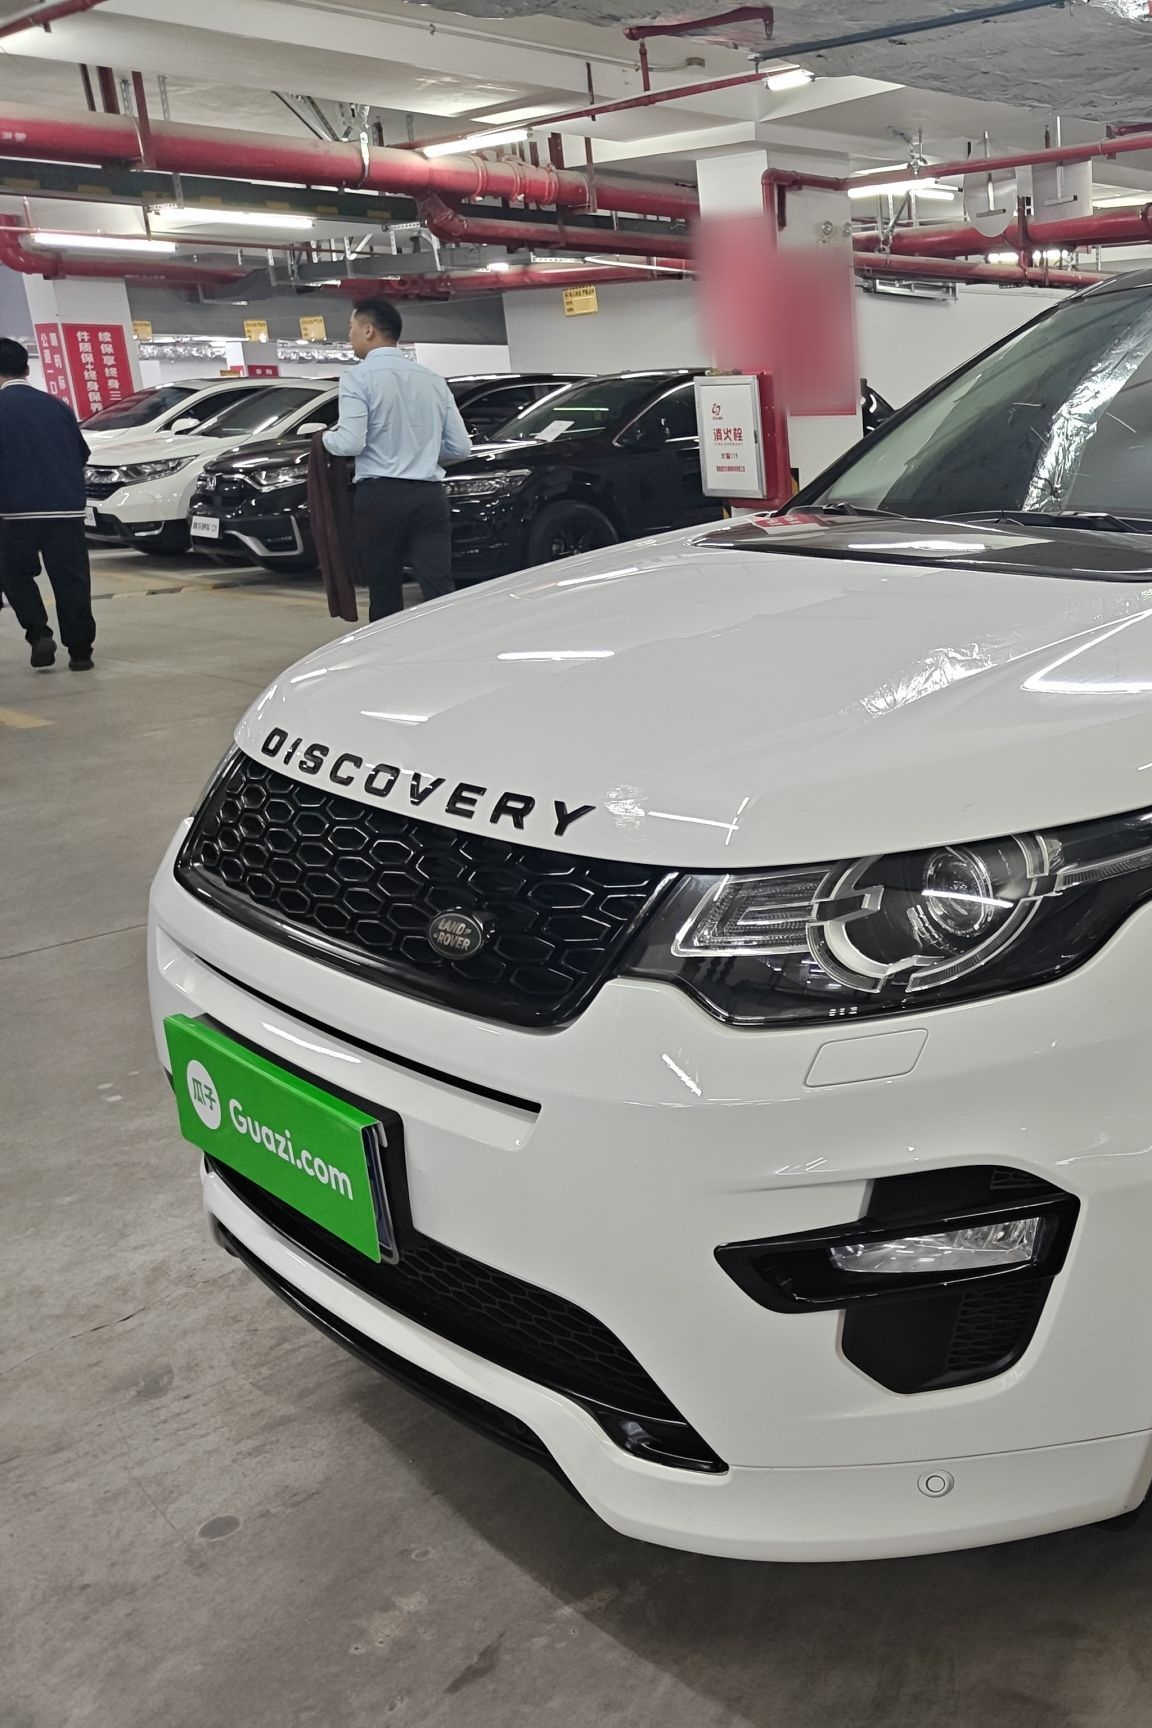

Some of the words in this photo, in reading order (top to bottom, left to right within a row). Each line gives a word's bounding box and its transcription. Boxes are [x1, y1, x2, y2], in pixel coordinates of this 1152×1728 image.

[713, 427, 743, 441] 消火栓
[261, 727, 596, 837] DISCOVERY
[438, 918, 466, 935] LAND
[437, 931, 471, 951] ROVER
[192, 1076, 217, 1111] 瓜子
[229, 1098, 353, 1201] Guazi.com
